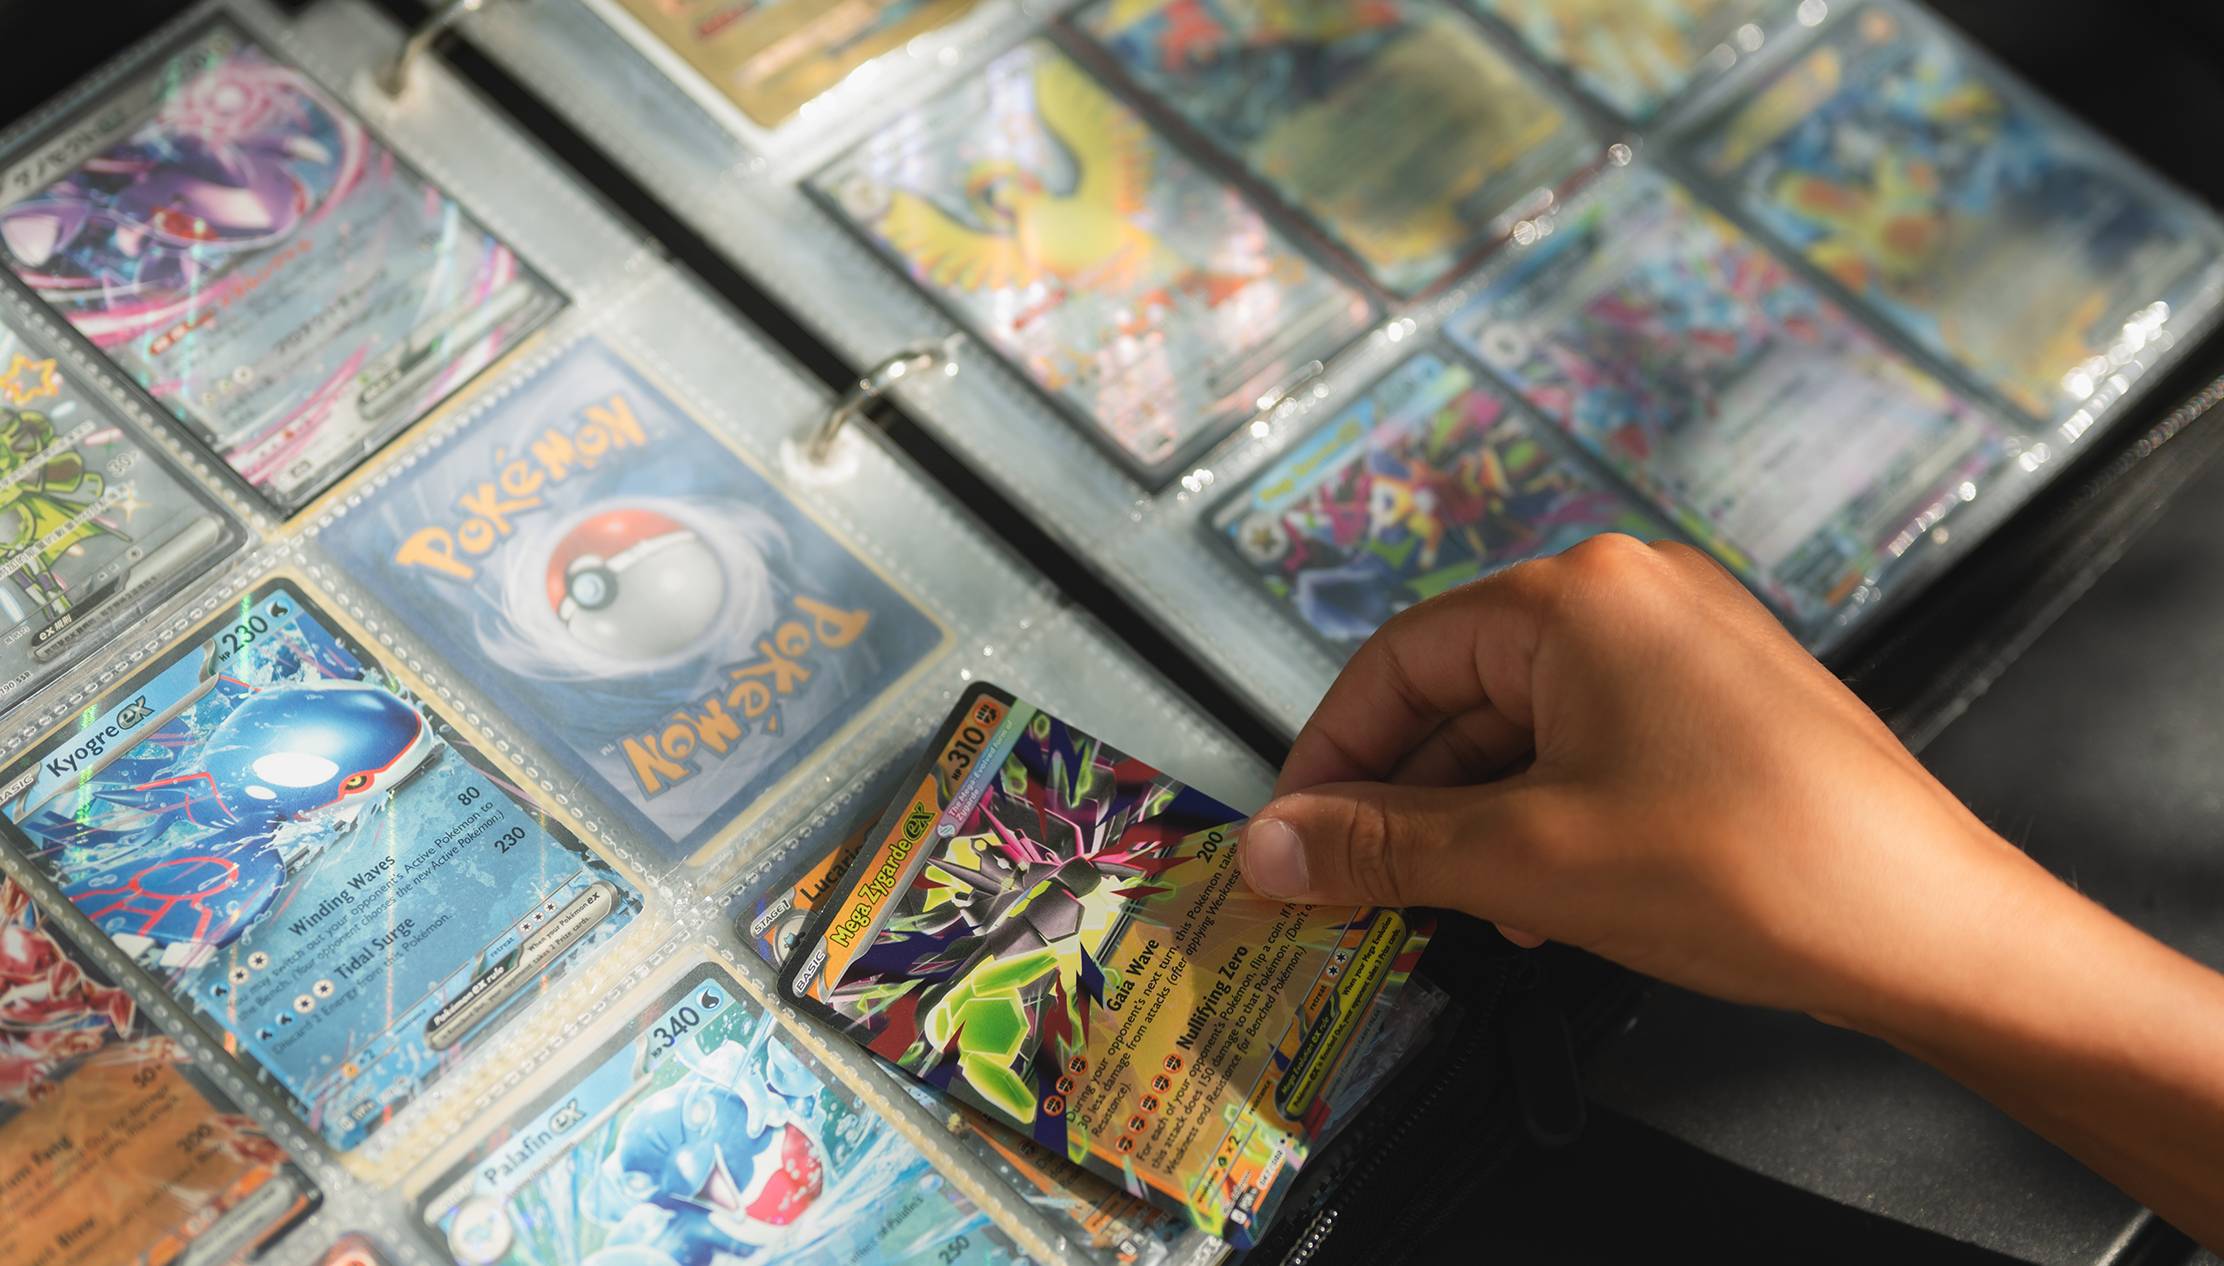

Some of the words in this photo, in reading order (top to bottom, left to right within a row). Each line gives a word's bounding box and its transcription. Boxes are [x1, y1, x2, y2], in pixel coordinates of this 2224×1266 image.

[222, 610, 270, 654] 230
[217, 648, 233, 664] HP
[111, 693, 155, 734] ex
[45, 718, 122, 783] Kyogre
[945, 722, 987, 770] 310
[0, 773, 34, 804] ASIC
[951, 767, 963, 781] HP
[897, 799, 938, 845] ex
[947, 798, 963, 817] The
[954, 787, 981, 822] Zygarde
[287, 885, 355, 942] Winding
[346, 851, 397, 894] Waves
[456, 783, 482, 808] 80
[303, 931, 326, 951] out
[323, 912, 352, 939] your
[347, 870, 406, 918] opponent's
[401, 844, 437, 874] Active
[432, 808, 482, 849] Pokémon
[479, 799, 494, 813] to
[800, 841, 865, 904] Lucari
[856, 832, 918, 909] Zygarde
[315, 922, 363, 962] opponent
[358, 894, 397, 926] chooses
[394, 880, 414, 898] the
[411, 867, 433, 885] new
[428, 843, 460, 871] Active
[455, 807, 506, 850] Pokémon.)
[333, 945, 376, 982] Tidal
[370, 912, 419, 955] Surge
[491, 823, 528, 855] 230
[584, 889, 601, 905] ex
[400, 909, 453, 953] Pokémon.
[828, 896, 877, 953] Mega
[1104, 975, 1136, 1013] Gaia
[1125, 934, 1161, 979] Wave
[1194, 828, 1225, 865] 200
[1263, 916, 1287, 945] coin.
[1279, 906, 1293, 919] If
[1282, 908, 1311, 943] (Don't
[487, 934, 516, 958] retreat
[1248, 950, 1269, 972] flip
[1252, 939, 1292, 992] Pokémon.
[1260, 943, 1271, 952] a
[1340, 976, 1357, 997] When
[1352, 961, 1367, 978] your
[1361, 943, 1378, 963] Mega
[1370, 914, 1394, 945] Evolution
[793, 948, 827, 993] BASIC
[1268, 943, 1308, 996] Pokémon.)
[1064, 1082, 1096, 1124] During
[1088, 1056, 1111, 1084] your
[1103, 995, 1149, 1058] opponent's
[1141, 969, 1163, 997] next
[1158, 941, 1181, 971] turn,
[1172, 918, 1193, 942] this
[1185, 869, 1223, 920] Pokémon
[1076, 1112, 1093, 1131] 30
[1085, 1090, 1107, 1115] less
[1099, 1050, 1134, 1094] damage
[1124, 1022, 1148, 1051] from
[1141, 984, 1172, 1024] attacks
[1164, 954, 1191, 986] (after
[1181, 912, 1216, 957] applying
[1205, 865, 1243, 916] Weakness
[1175, 977, 1232, 1053] Nullifying
[1217, 941, 1250, 980] Zero
[1217, 967, 1257, 1021] Pokémon,
[1240, 989, 1262, 1015] that
[1243, 992, 1277, 1037] Benched
[1307, 983, 1328, 1011] retreat
[1234, 1013, 1248, 1028] to
[1183, 1018, 1229, 1079] opponent's
[1208, 1026, 1243, 1069] damage
[1234, 1035, 1254, 1055] for
[481, 1124, 557, 1188] Palafin
[650, 1002, 703, 1050] 340
[1171, 1077, 1194, 1105] your
[1196, 1065, 1217, 1088] 150
[1204, 1051, 1244, 1105] Resistance
[1090, 1078, 1133, 1138] Resistance).
[1162, 1101, 1177, 1117] of
[1181, 1087, 1204, 1115] does
[1192, 1102, 1212, 1126] and
[1146, 1114, 1170, 1142] each
[1160, 1113, 1188, 1149] attack
[1134, 1140, 1154, 1162] For
[1148, 1147, 1168, 1170] this
[1161, 1124, 1200, 1176] Weakness
[935, 1232, 973, 1266] 250
